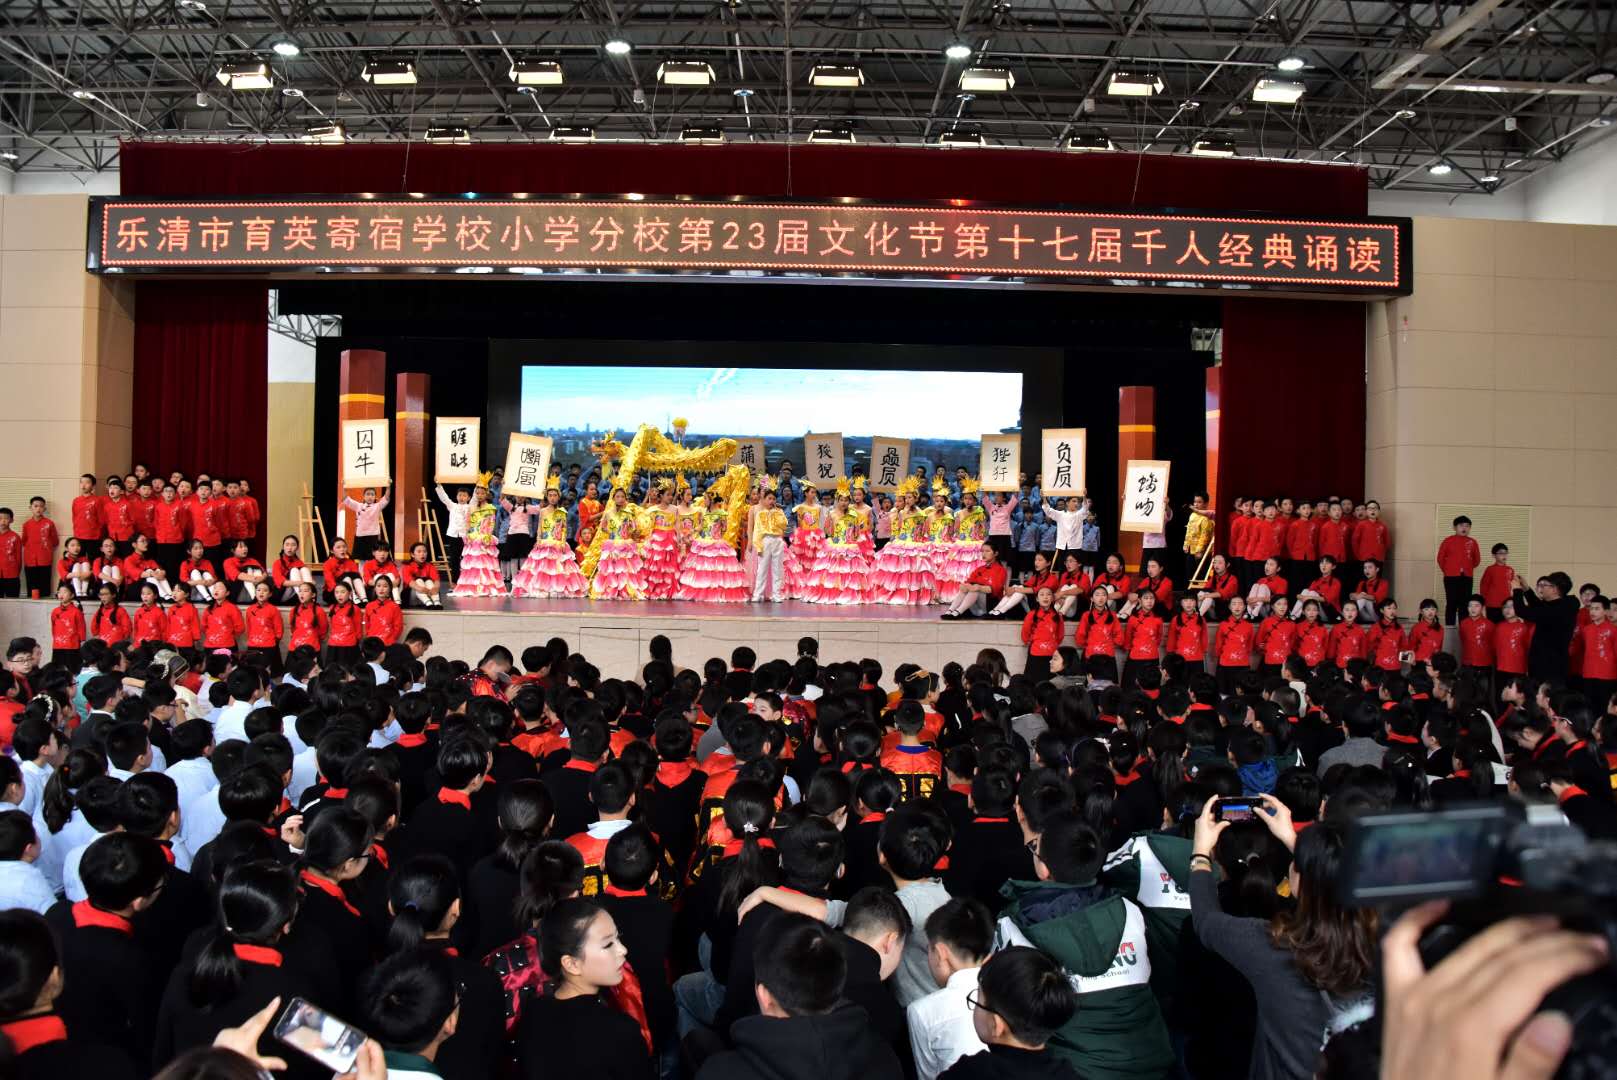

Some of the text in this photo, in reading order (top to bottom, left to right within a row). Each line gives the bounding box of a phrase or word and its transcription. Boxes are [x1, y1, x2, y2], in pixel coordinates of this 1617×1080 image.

[116, 214, 1381, 273] 乐清市育英寄宿学校小学分校第23届文化节第十七届千人经典诵读
[354, 429, 374, 475] 囚牛
[1053, 441, 1072, 488] 负屃
